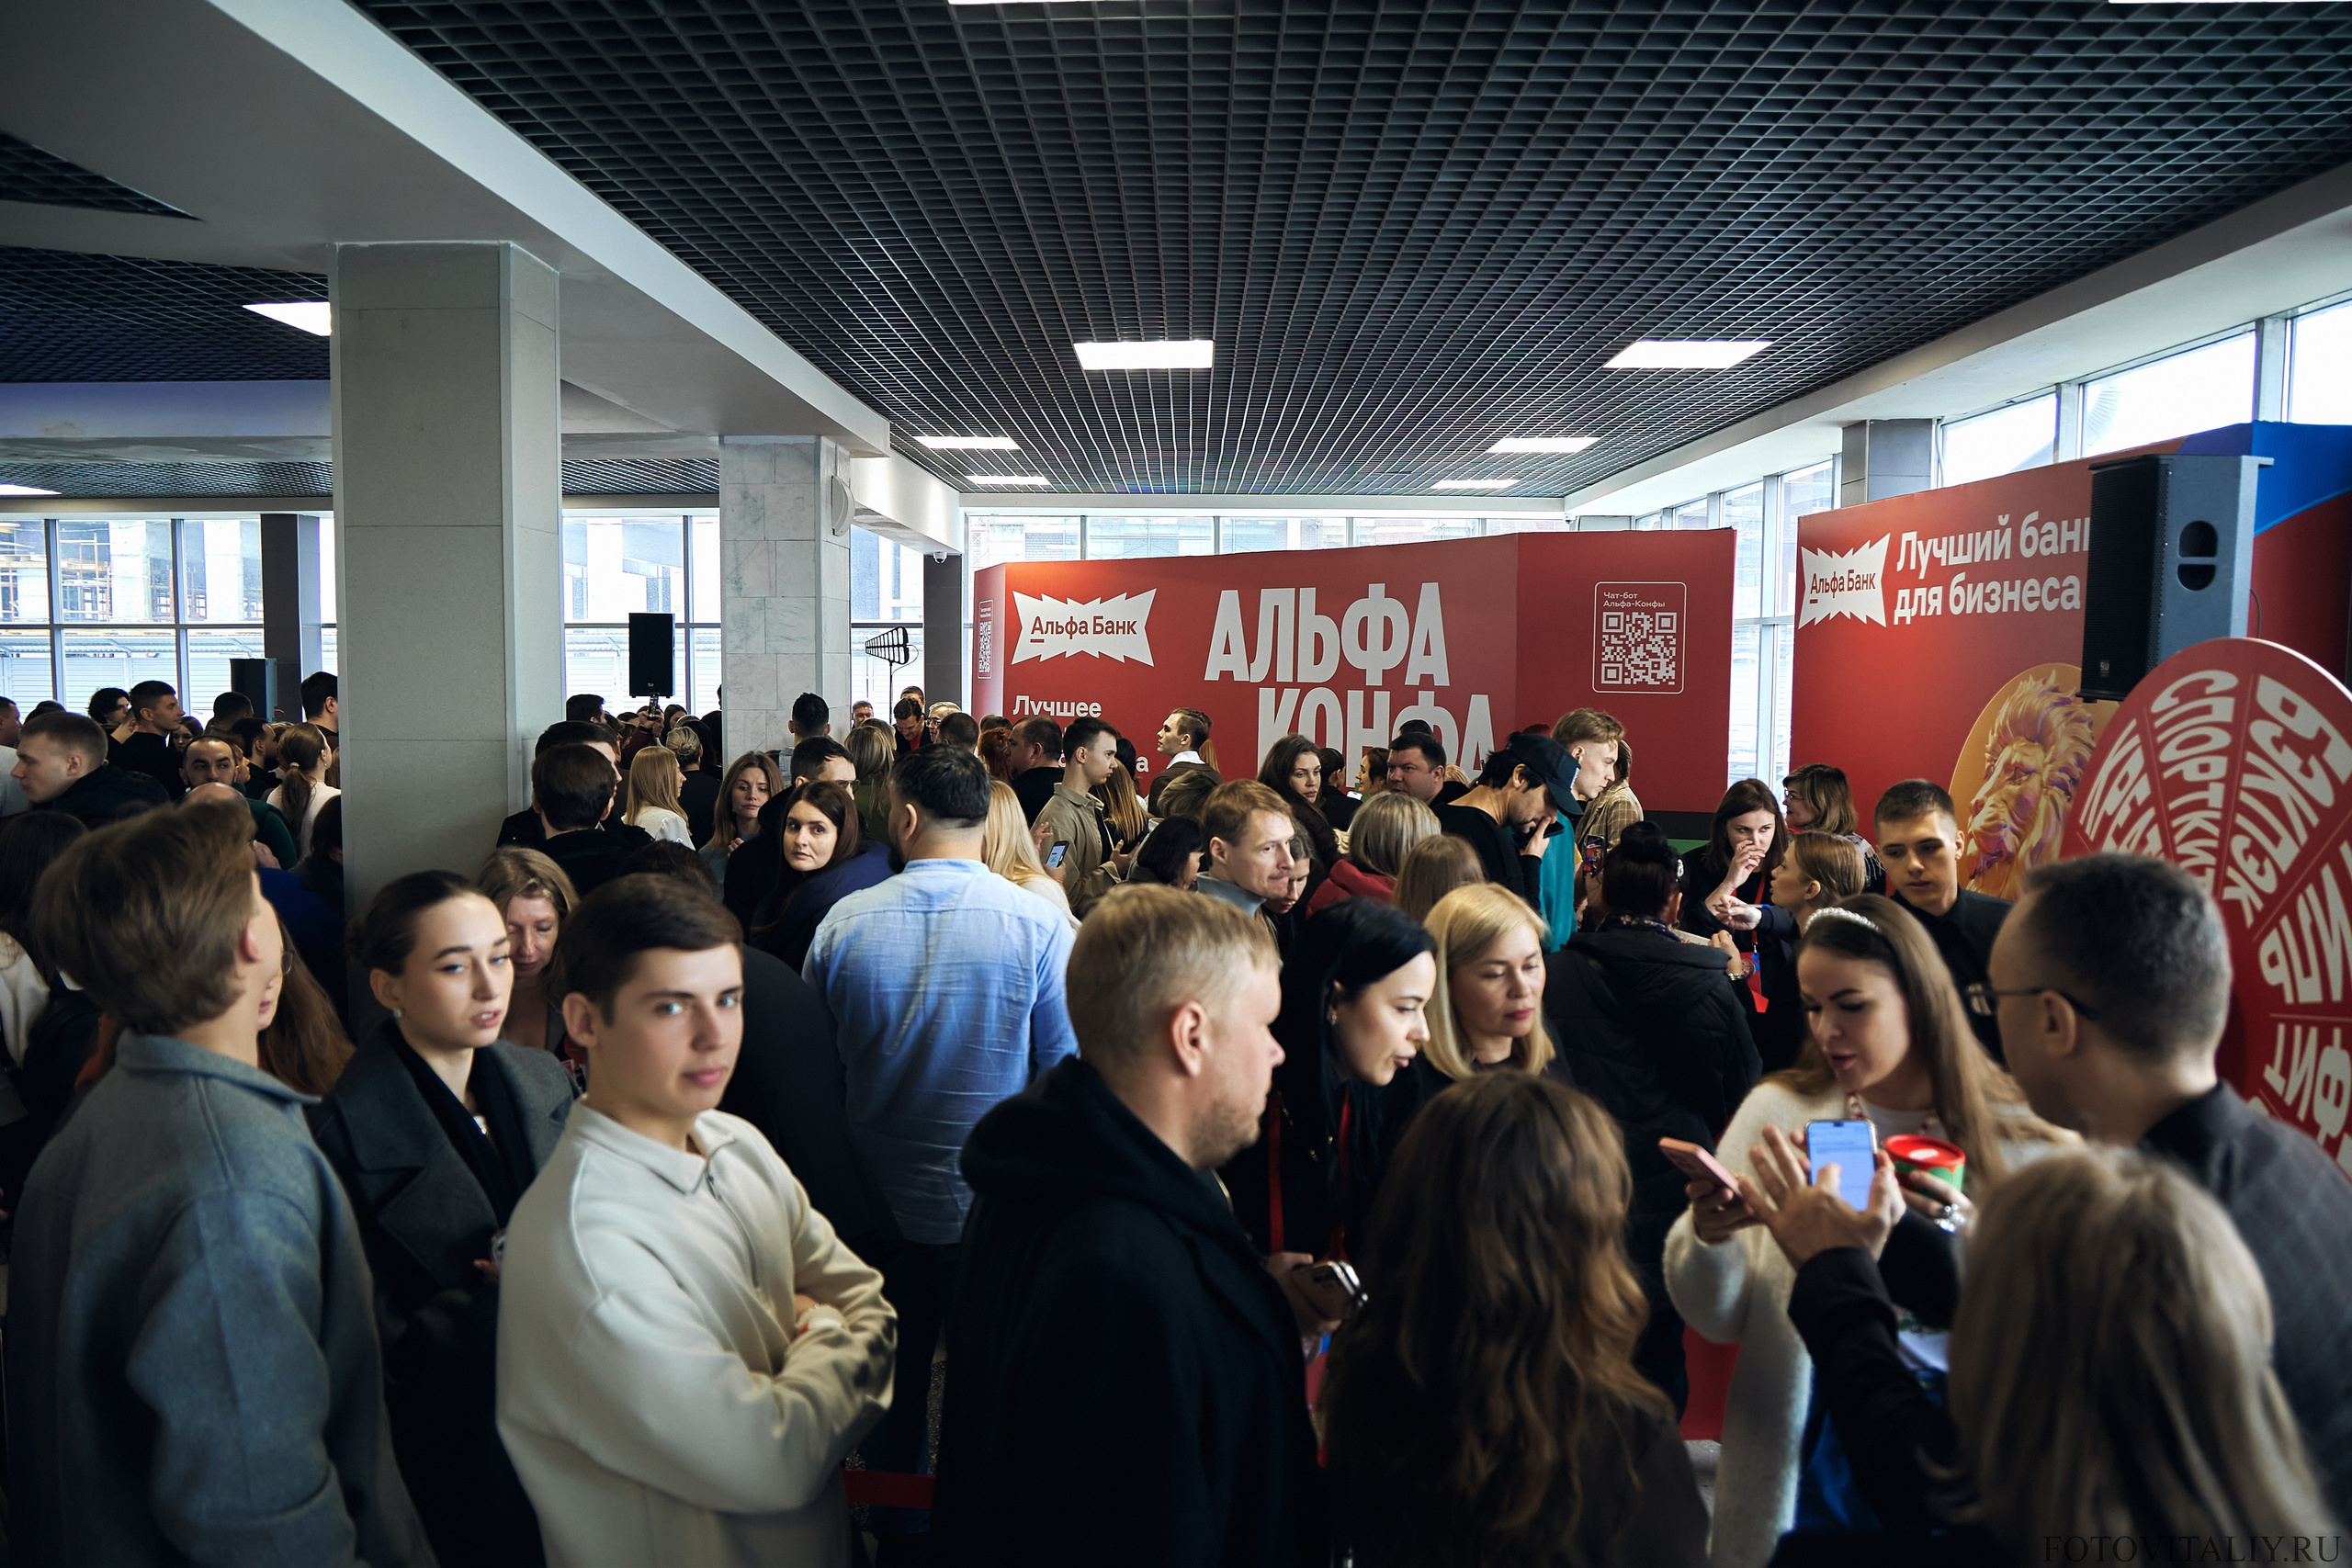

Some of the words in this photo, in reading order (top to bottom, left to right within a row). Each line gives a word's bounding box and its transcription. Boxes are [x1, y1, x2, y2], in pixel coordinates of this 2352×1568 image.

[1896, 513, 2012, 580] Лучший
[1810, 571, 1845, 599] Альфа
[1847, 569, 1876, 592] Банк
[1894, 585, 1943, 626] для
[1949, 571, 2081, 615] бизнеса
[1603, 600, 1666, 609] Альфа-Конфы
[1030, 615, 1089, 640] Альфа
[1092, 615, 1137, 635] Банк
[1204, 581, 1451, 687] АЛЬФА
[1012, 694, 1102, 718] Лучшее
